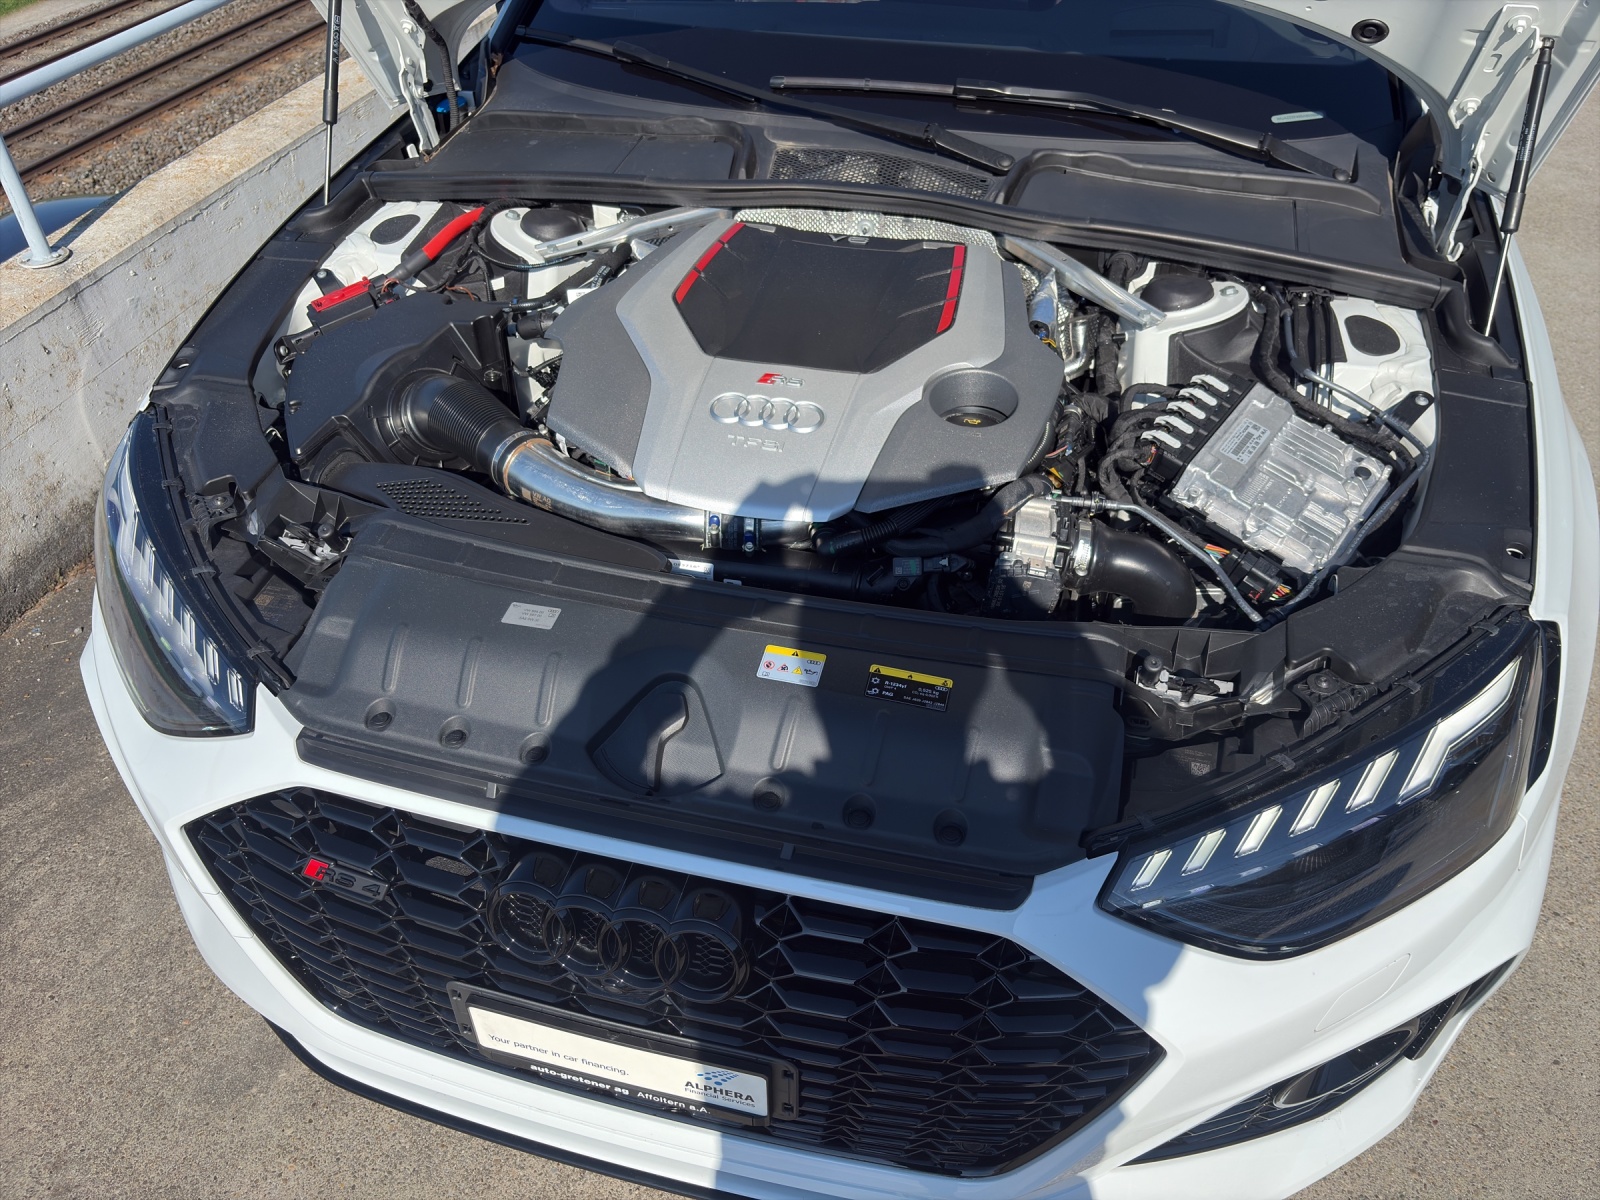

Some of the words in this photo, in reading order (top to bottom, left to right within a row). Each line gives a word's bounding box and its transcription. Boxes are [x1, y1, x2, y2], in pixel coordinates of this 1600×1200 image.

[828, 233, 869, 245] V6
[756, 372, 805, 388] RS
[727, 434, 785, 453] TFSI
[303, 858, 357, 888] RS
[362, 883, 381, 897] 4
[488, 1034, 510, 1044] Your
[513, 1041, 548, 1055] partner
[551, 1050, 560, 1058] in
[563, 1054, 578, 1062] car
[581, 1058, 629, 1076] financing.
[530, 1064, 611, 1090] auto-gretener
[614, 1086, 630, 1095] ag
[637, 1091, 686, 1108] Affoltern
[689, 1104, 711, 1114] a.A.
[684, 1081, 755, 1103] ALPHERA
[684, 1087, 719, 1100] Financial
[721, 1095, 756, 1108] Services
